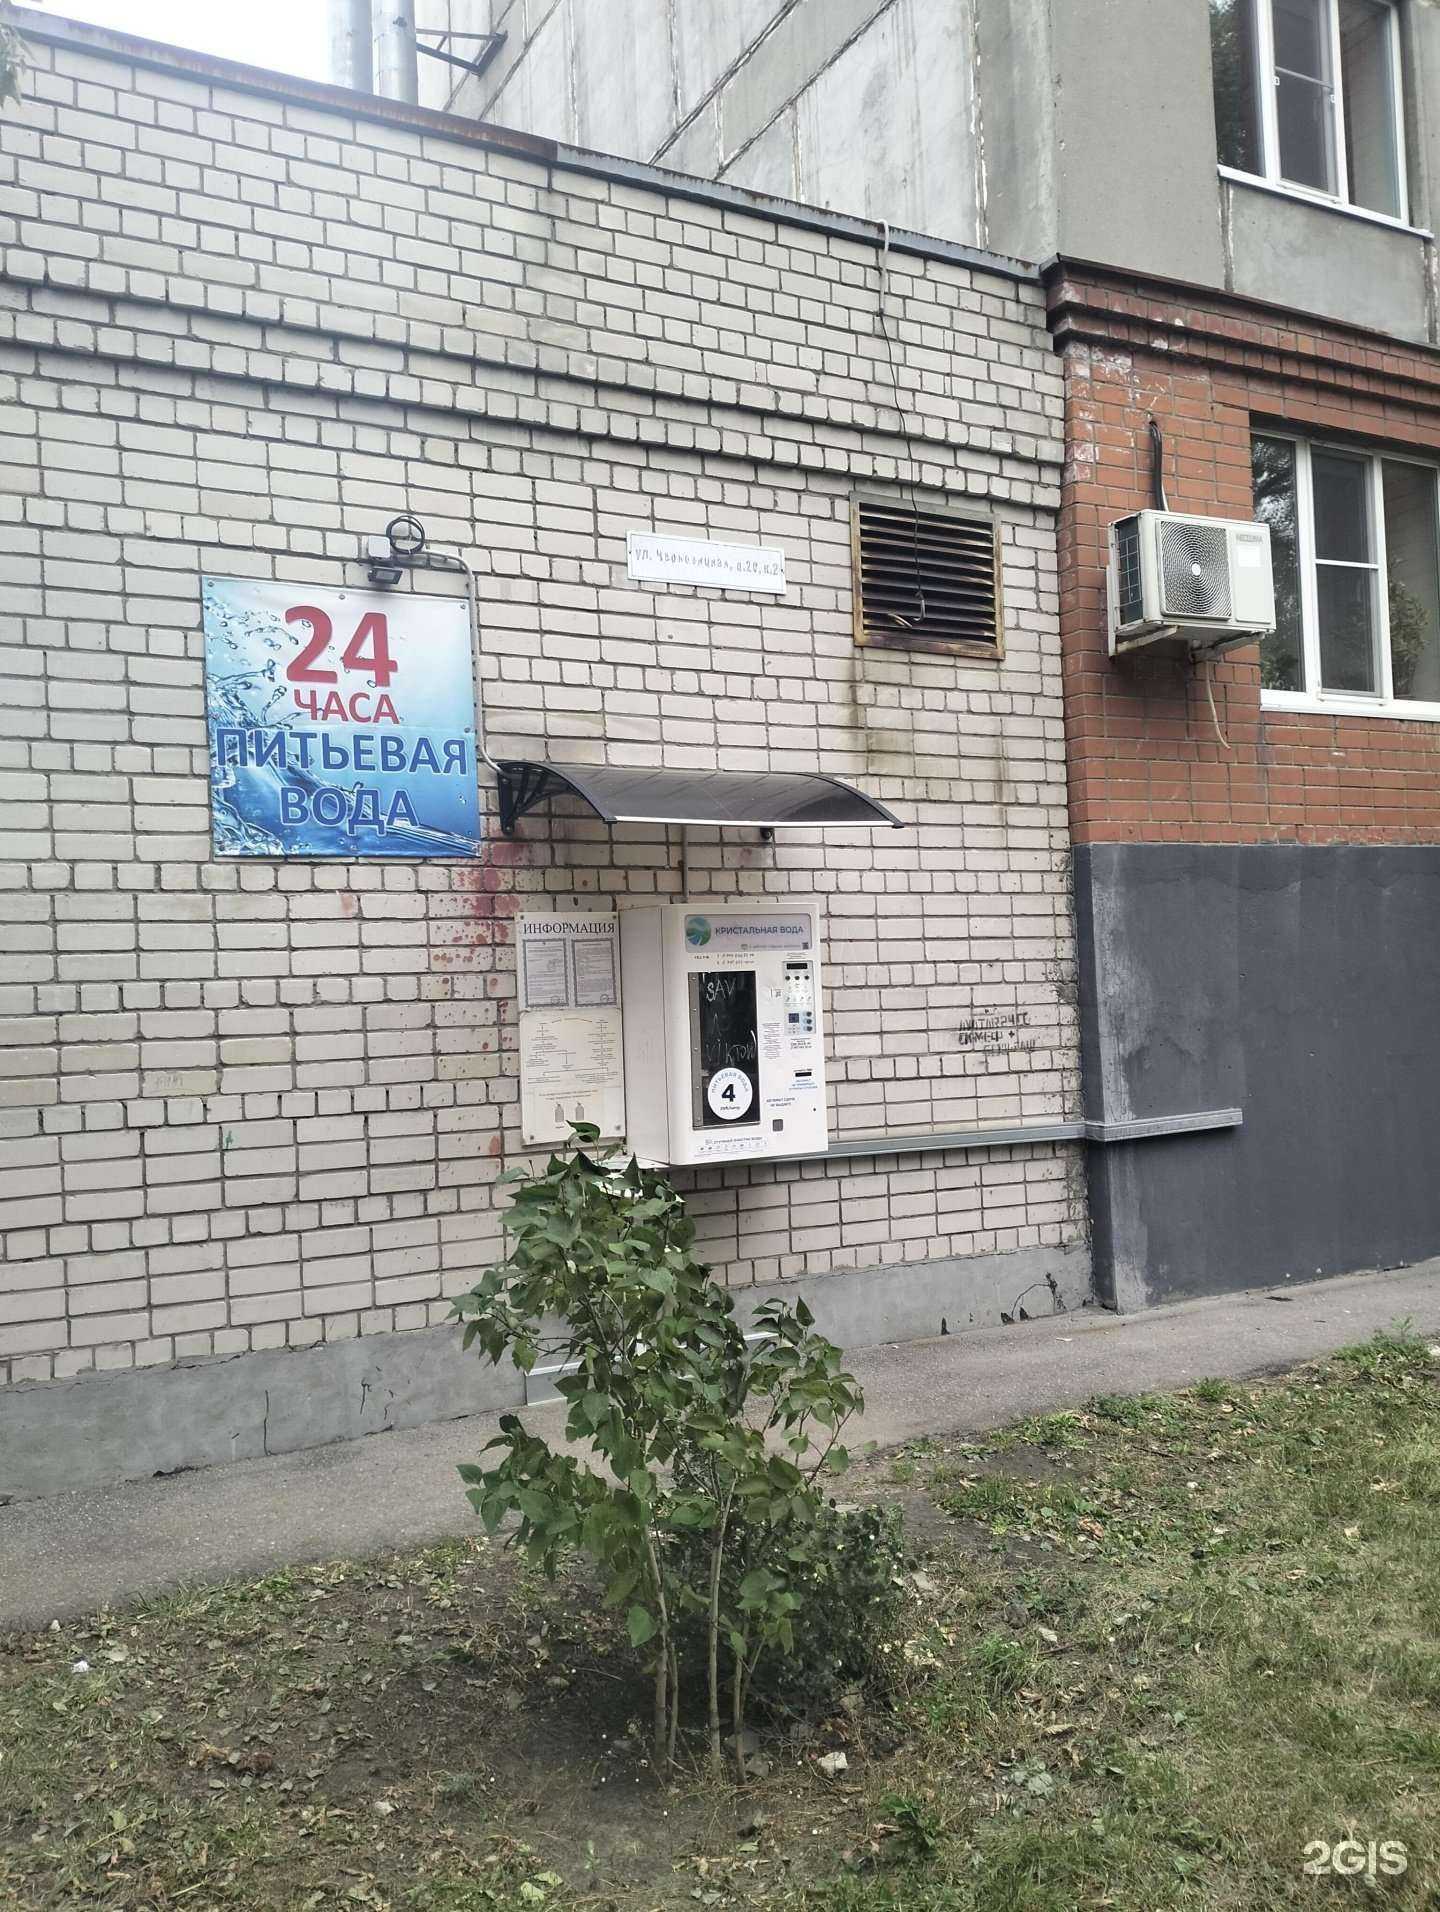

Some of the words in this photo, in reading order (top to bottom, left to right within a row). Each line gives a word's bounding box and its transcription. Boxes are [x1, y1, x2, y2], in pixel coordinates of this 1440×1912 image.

[635, 548, 653, 562] ул.
[284, 605, 399, 687] 24
[293, 689, 400, 724] ЧАСА
[215, 728, 468, 776] ПИТЬЕВАЯ
[279, 786, 420, 837] ВОДА
[523, 922, 616, 936] ИНФОРМАЦИЯ
[714, 926, 778, 936] КРИСТАЛЬНАЯ
[780, 925, 805, 934] ВОДА
[711, 1071, 737, 1094] ПИТЬЕВАЯ
[721, 1083, 736, 1102] 4
